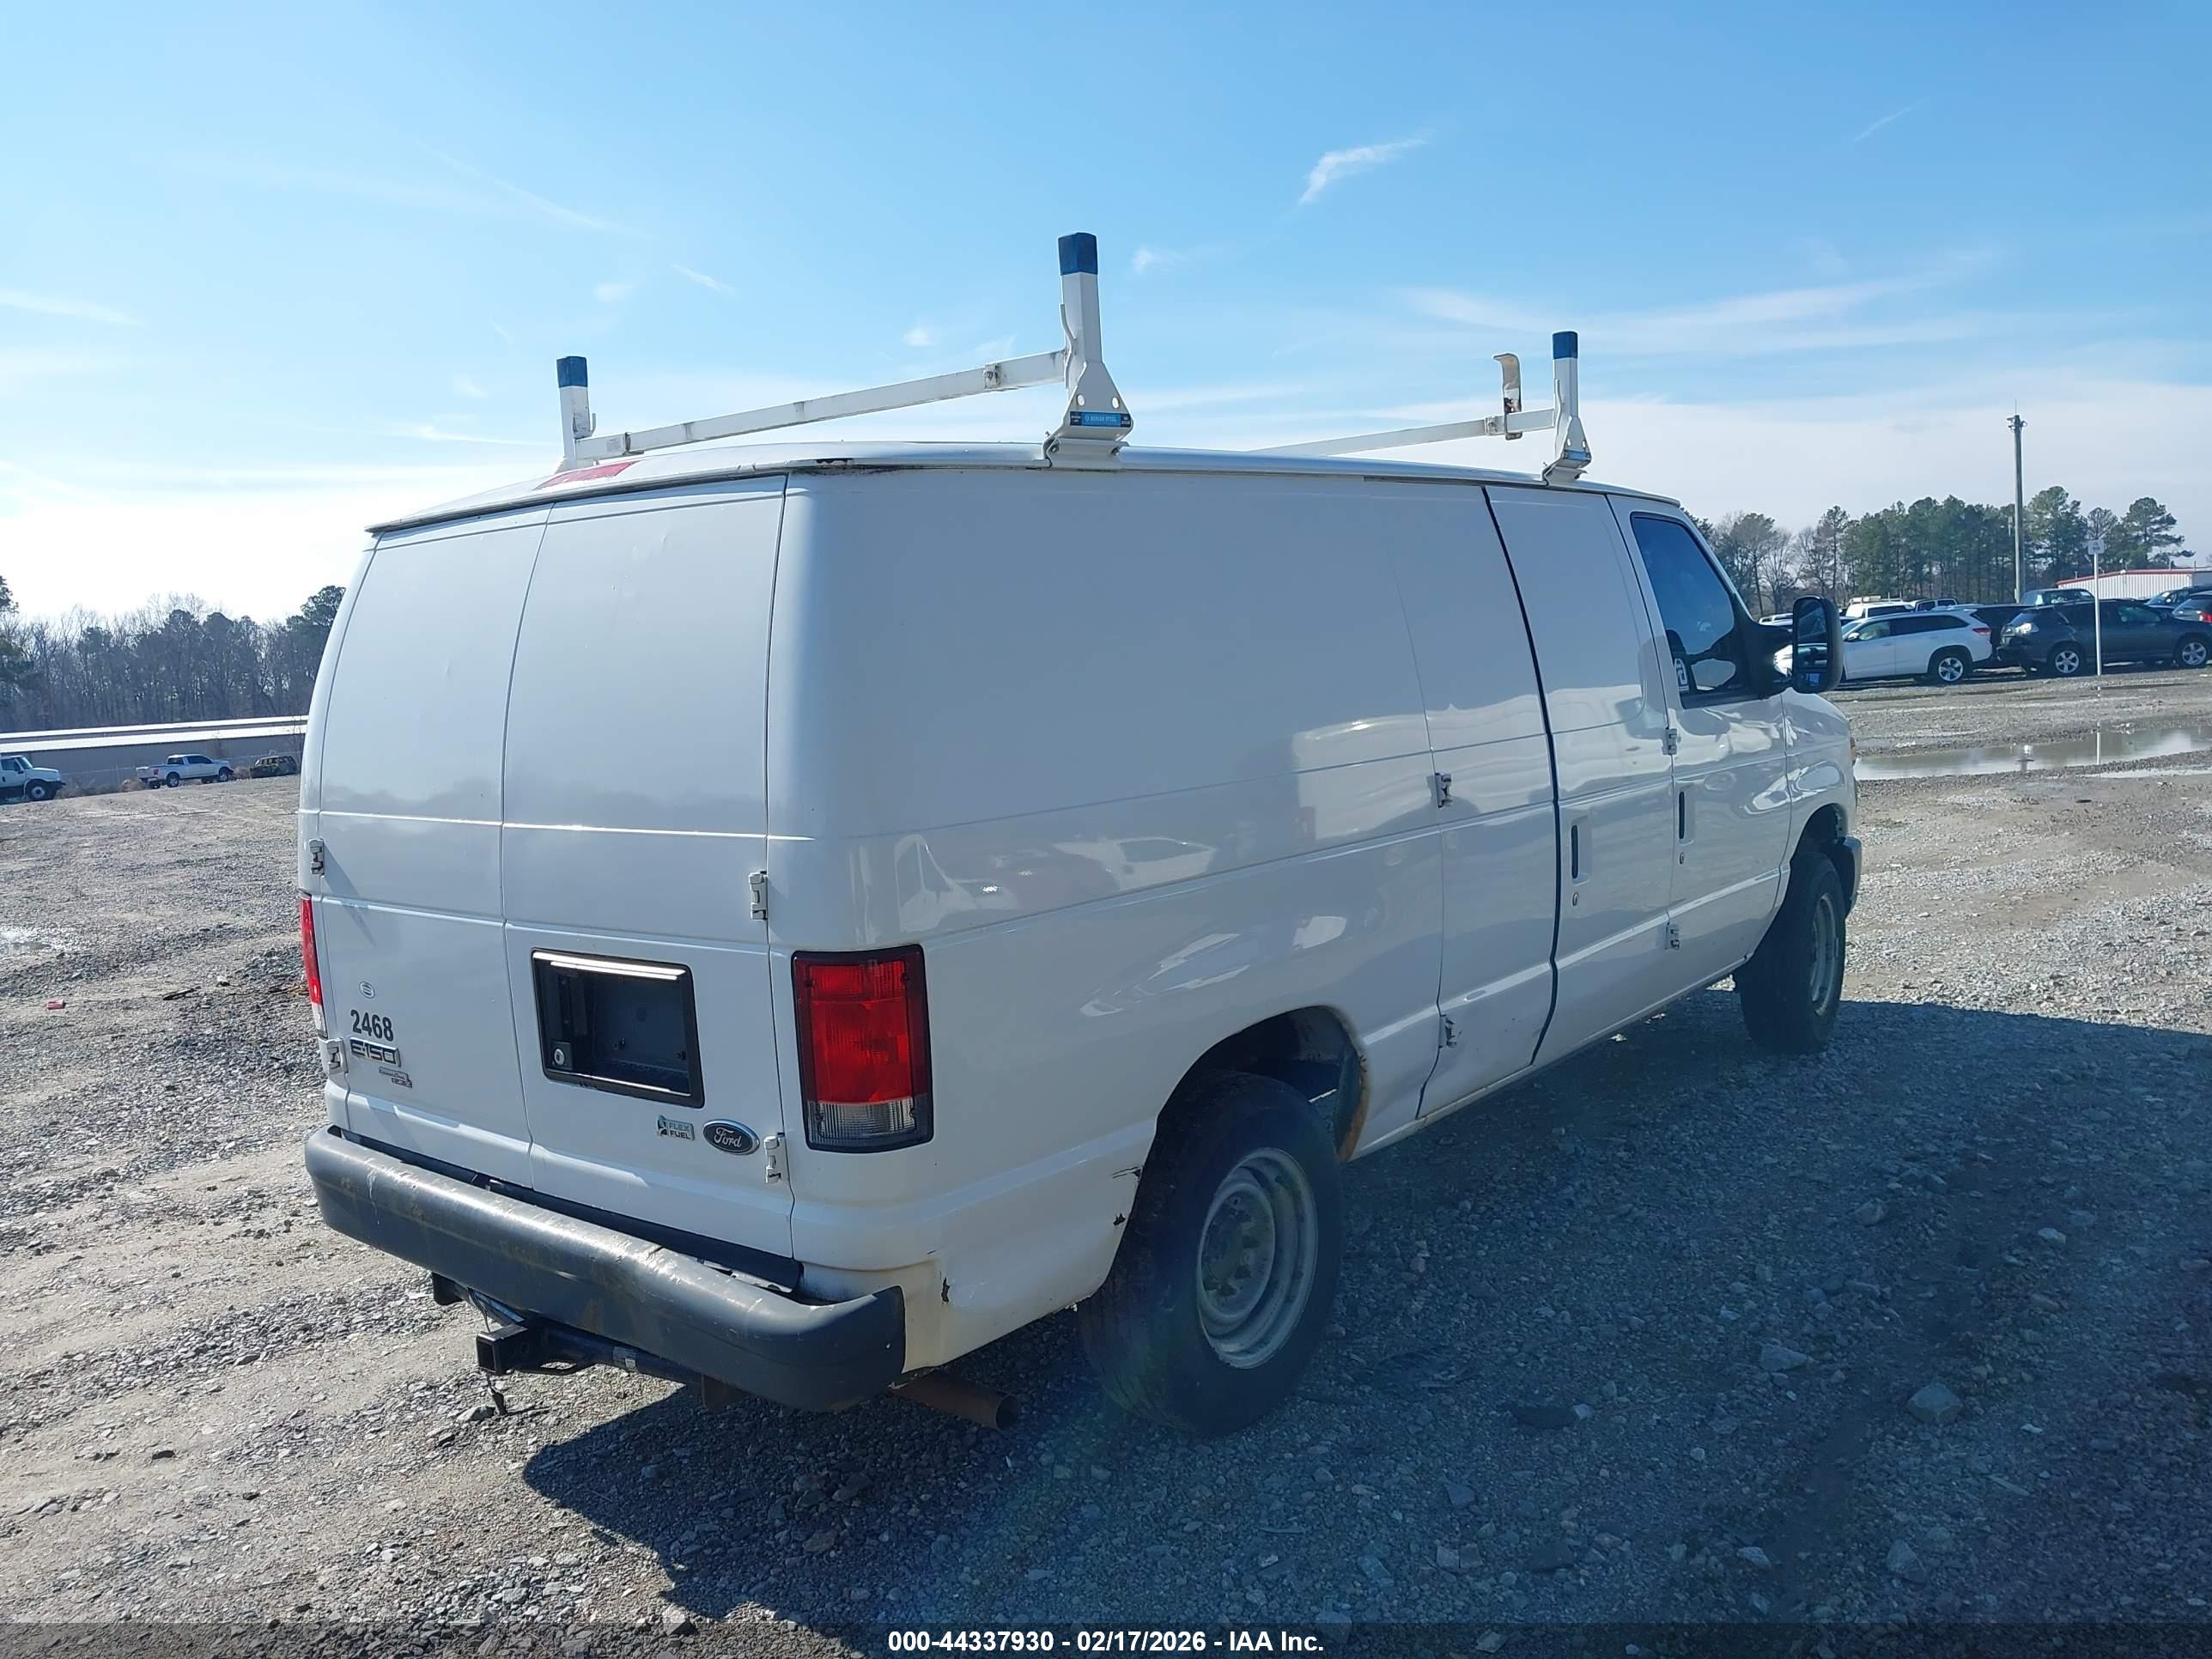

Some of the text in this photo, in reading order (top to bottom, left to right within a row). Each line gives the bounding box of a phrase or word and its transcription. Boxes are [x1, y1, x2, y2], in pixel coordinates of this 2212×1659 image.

[350, 1009, 394, 1042] 2468
[669, 1122, 690, 1133] FLEX
[670, 1130, 692, 1140] FUEL
[714, 1126, 743, 1148] Ford
